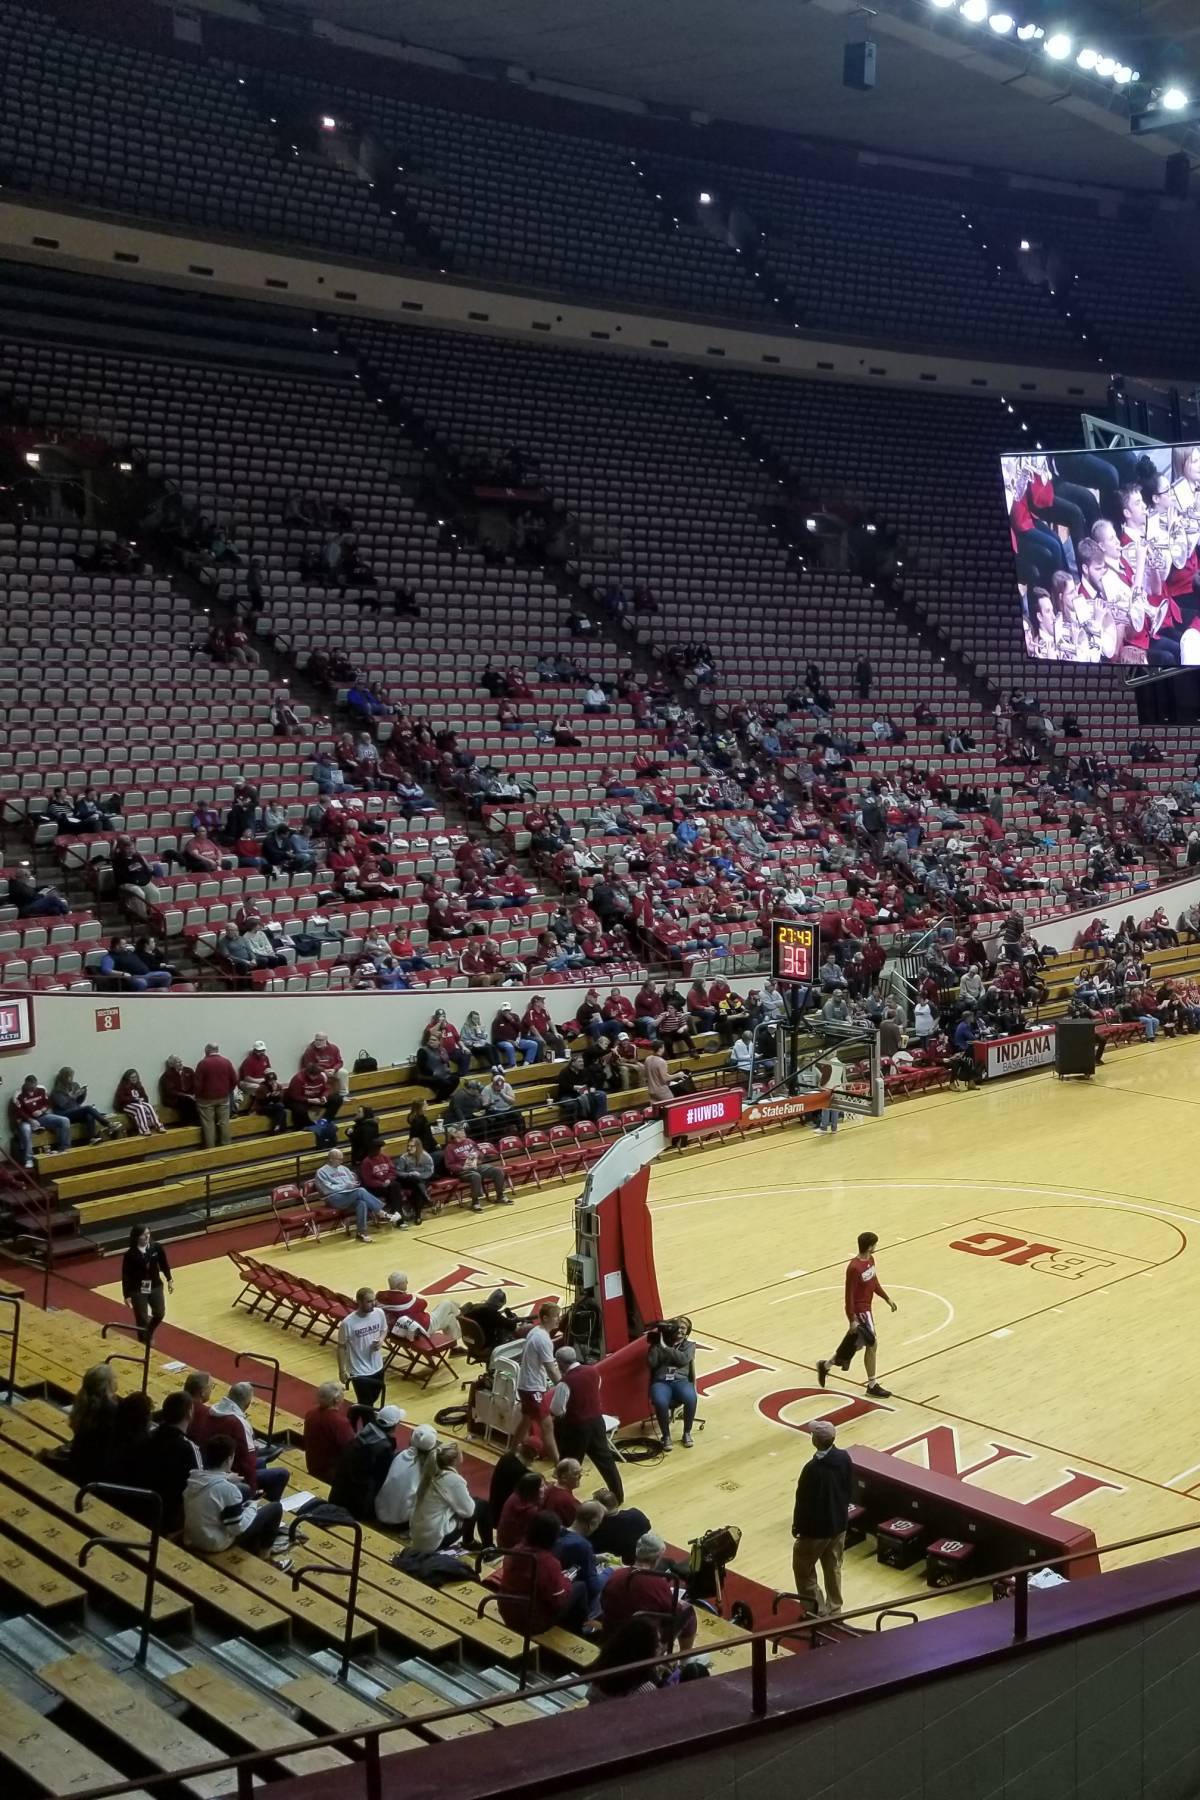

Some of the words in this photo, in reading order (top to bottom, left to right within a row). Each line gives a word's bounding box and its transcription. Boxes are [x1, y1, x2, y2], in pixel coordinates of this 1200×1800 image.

[780, 927, 811, 946] 27:43
[784, 946, 806, 975] 30
[104, 1016, 112, 1028] 8
[997, 1036, 1050, 1063] INDIANA
[1003, 1056, 1046, 1072] BASKETBALL
[686, 1103, 724, 1124] #IUWBB
